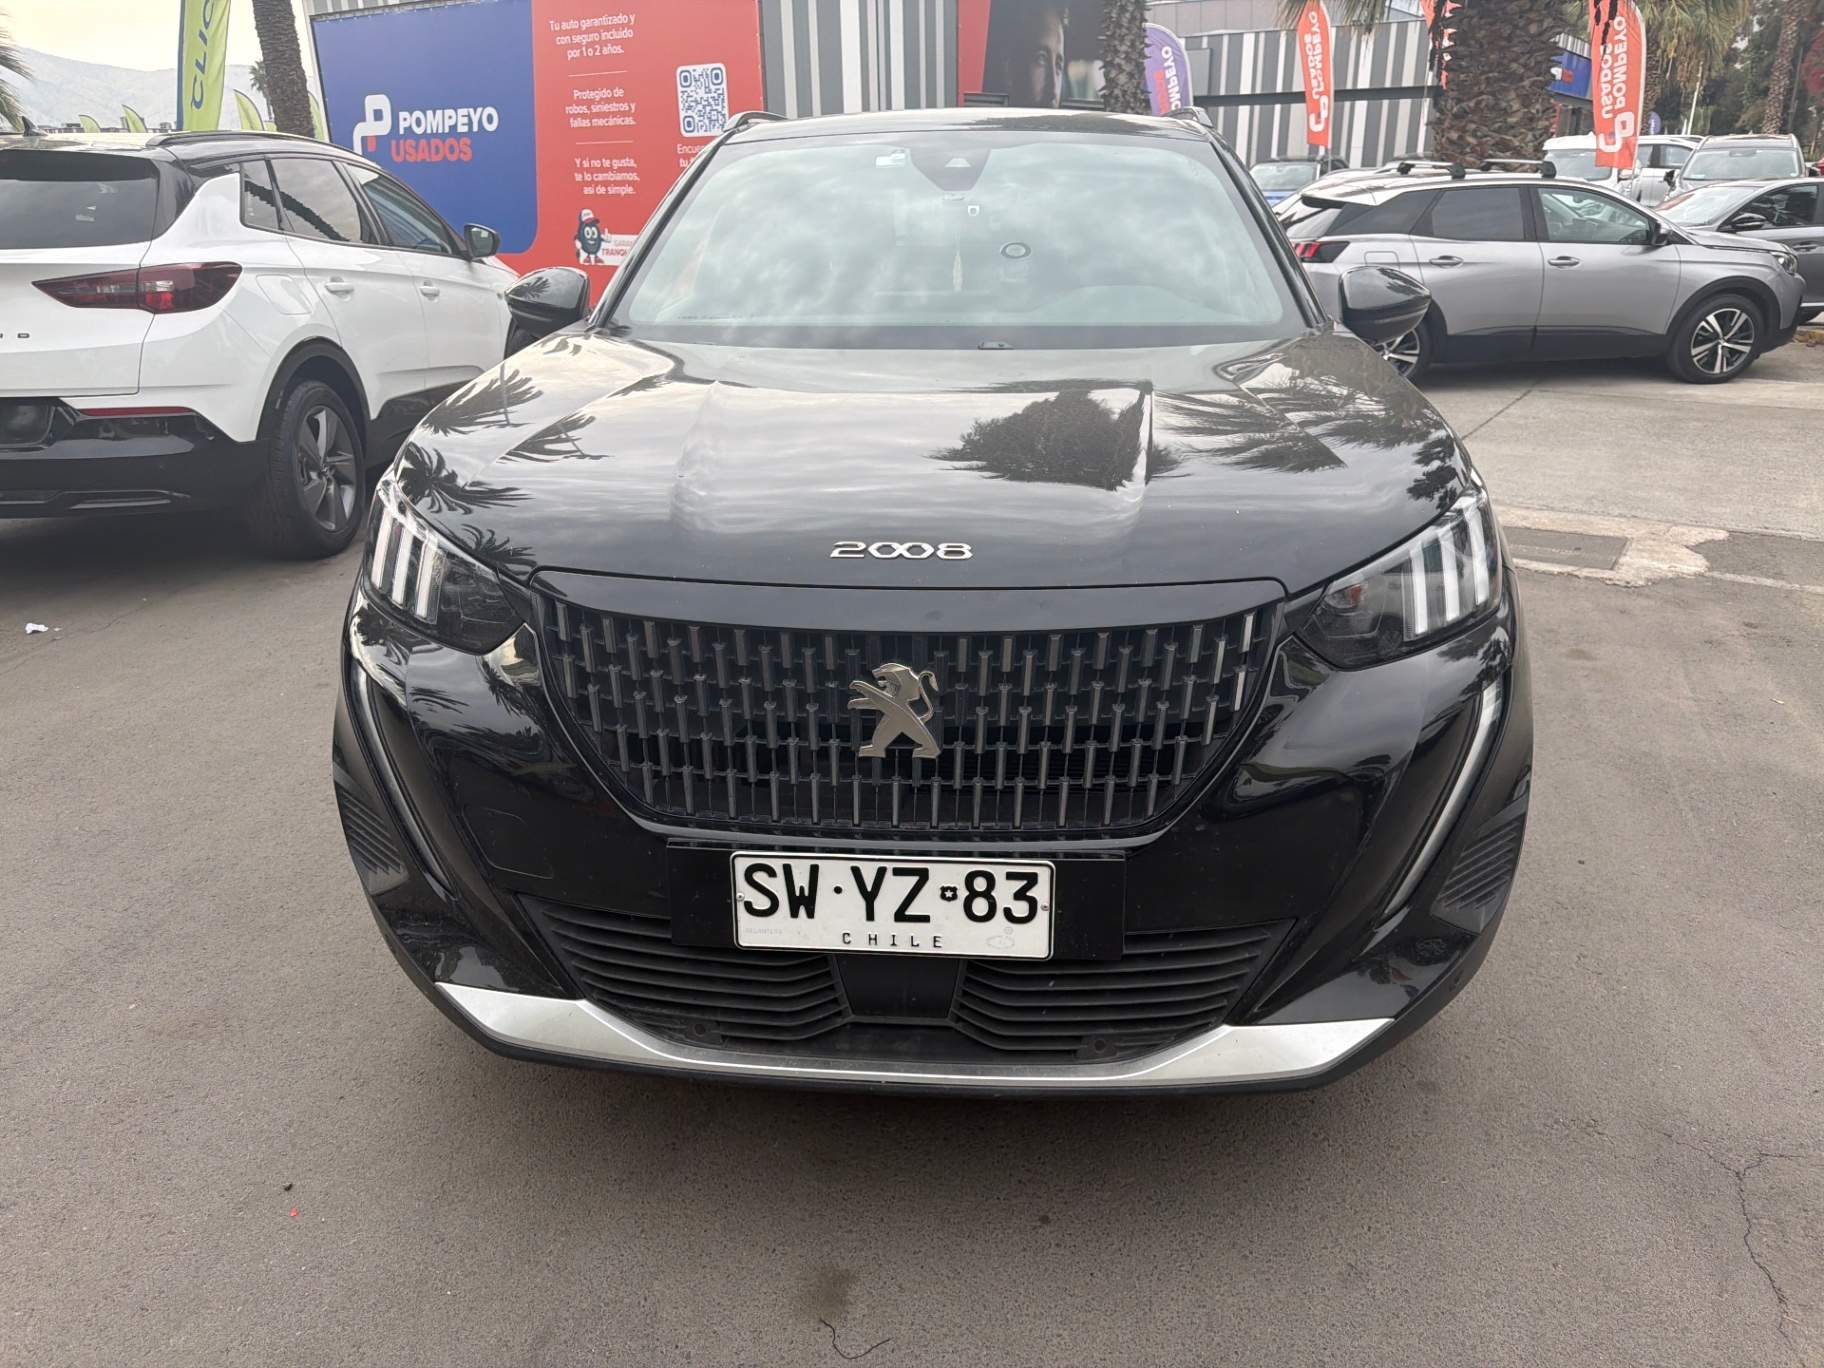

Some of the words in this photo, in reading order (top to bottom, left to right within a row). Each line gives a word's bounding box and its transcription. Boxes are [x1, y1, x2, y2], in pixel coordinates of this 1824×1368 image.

[549, 20, 561, 31] Tu
[561, 19, 579, 30] auto
[580, 13, 629, 30] garantizado
[629, 13, 636, 26] y
[556, 35, 571, 45] con
[572, 31, 600, 45] seguro
[600, 27, 634, 40] incluido
[567, 49, 581, 60] por
[594, 45, 601, 56] 2
[602, 43, 624, 55] años.
[573, 88, 612, 101] Protegido
[613, 87, 624, 97] de
[565, 104, 590, 115] robos,
[590, 102, 629, 113] siniestros
[629, 102, 636, 113] y
[398, 106, 499, 135] POMPEYO
[569, 117, 591, 128] fallas
[391, 136, 473, 163] USADOS
[676, 144, 704, 154] Encue
[590, 160, 601, 168] no
[602, 157, 611, 168] te
[575, 172, 583, 181] te
[583, 171, 592, 181] lo
[595, 184, 606, 195] de
[607, 184, 636, 196] simple.
[602, 248, 628, 257] TRANQ
[830, 541, 973, 560] 2008
[842, 932, 943, 949] CHILE
